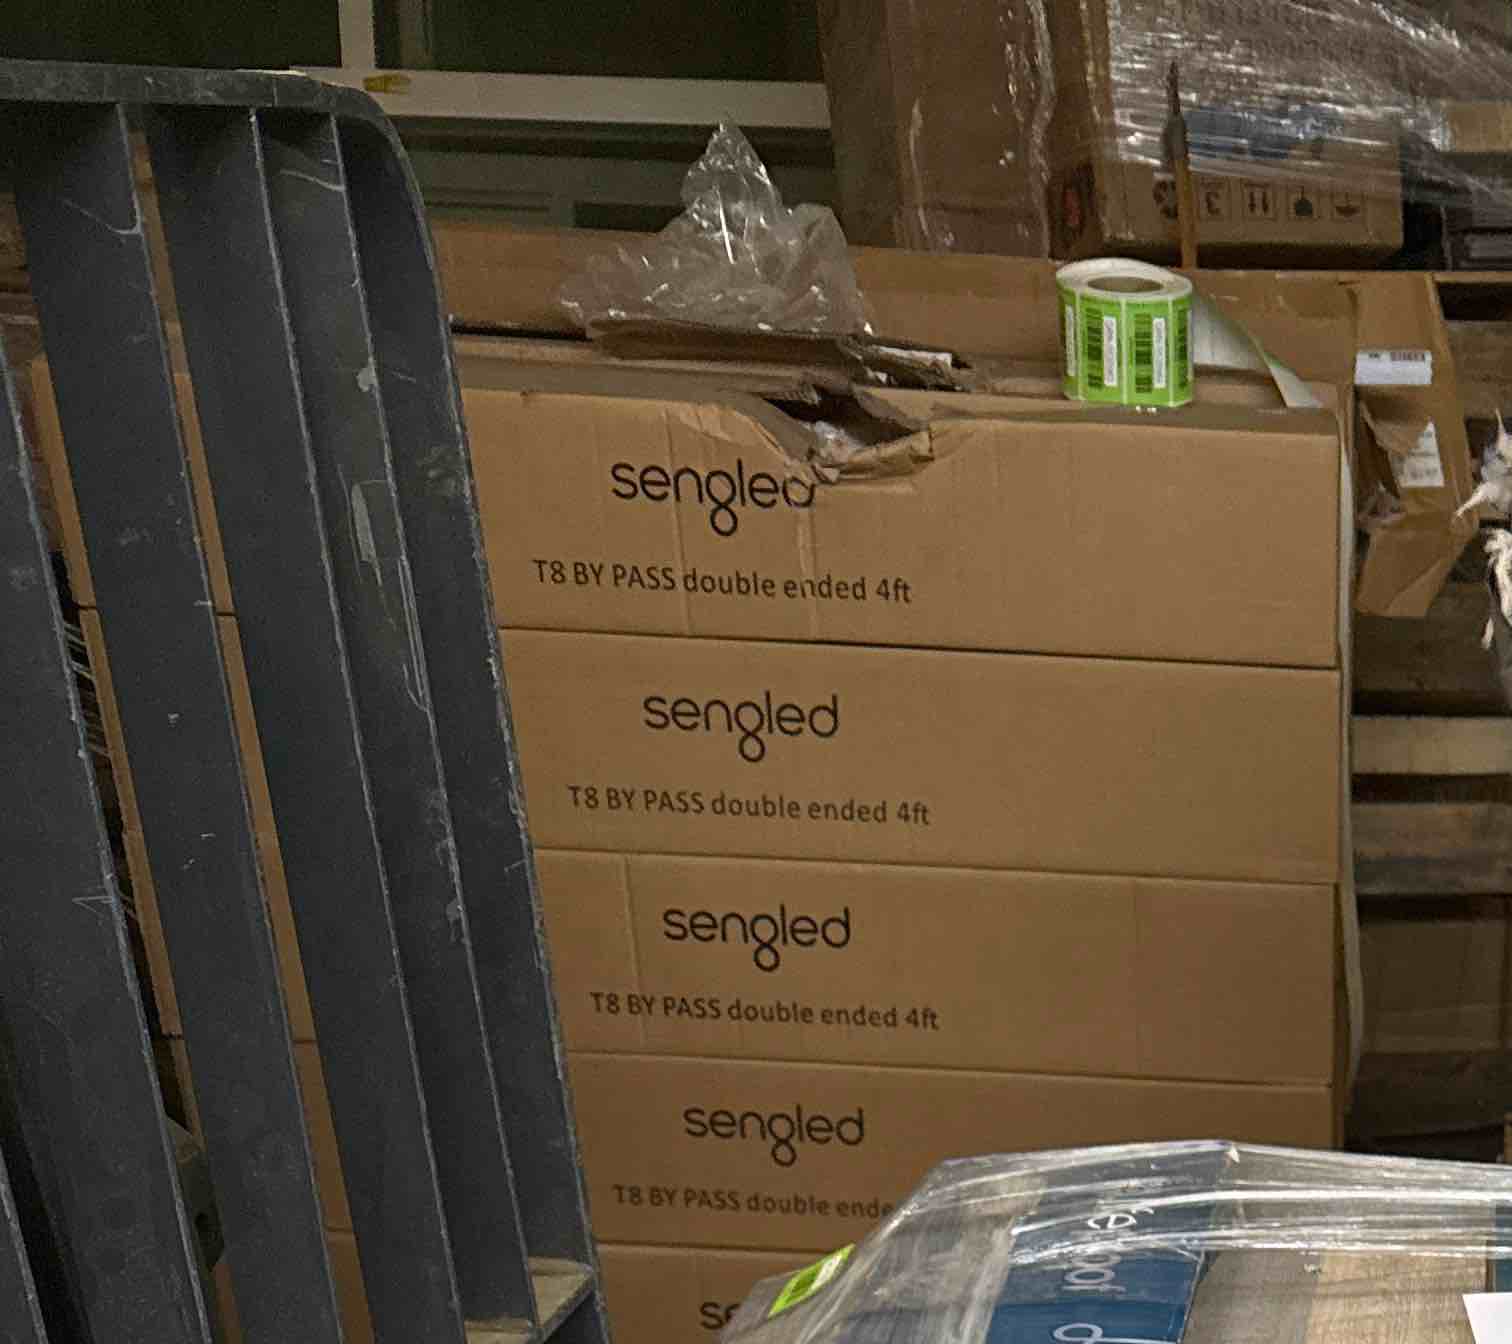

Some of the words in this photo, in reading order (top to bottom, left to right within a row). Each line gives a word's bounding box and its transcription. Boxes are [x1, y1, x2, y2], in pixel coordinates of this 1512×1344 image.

[533, 559, 566, 585] T8
[573, 561, 604, 587] BY
[612, 563, 676, 592] PASS
[684, 568, 776, 598] double
[784, 574, 867, 601] ended
[876, 577, 913, 604] 4ft
[643, 690, 840, 764] sengled
[567, 784, 600, 810] T8
[606, 787, 636, 811] BY
[644, 788, 705, 815] PASS
[711, 792, 801, 820] double
[807, 797, 888, 824] ended
[896, 801, 931, 826] 4ft
[663, 903, 850, 973] sengled
[590, 991, 621, 1016] T8
[627, 993, 658, 1017] BY
[663, 995, 722, 1020] PASS
[727, 999, 814, 1025] double
[820, 1003, 898, 1029] ended
[904, 1007, 940, 1031] 4ft
[683, 1104, 865, 1168] sengled
[613, 1184, 642, 1206] T8
[649, 1186, 679, 1207] BY
[683, 1188, 740, 1212] PASS
[747, 1192, 832, 1217] double
[836, 1197, 896, 1220] ende
